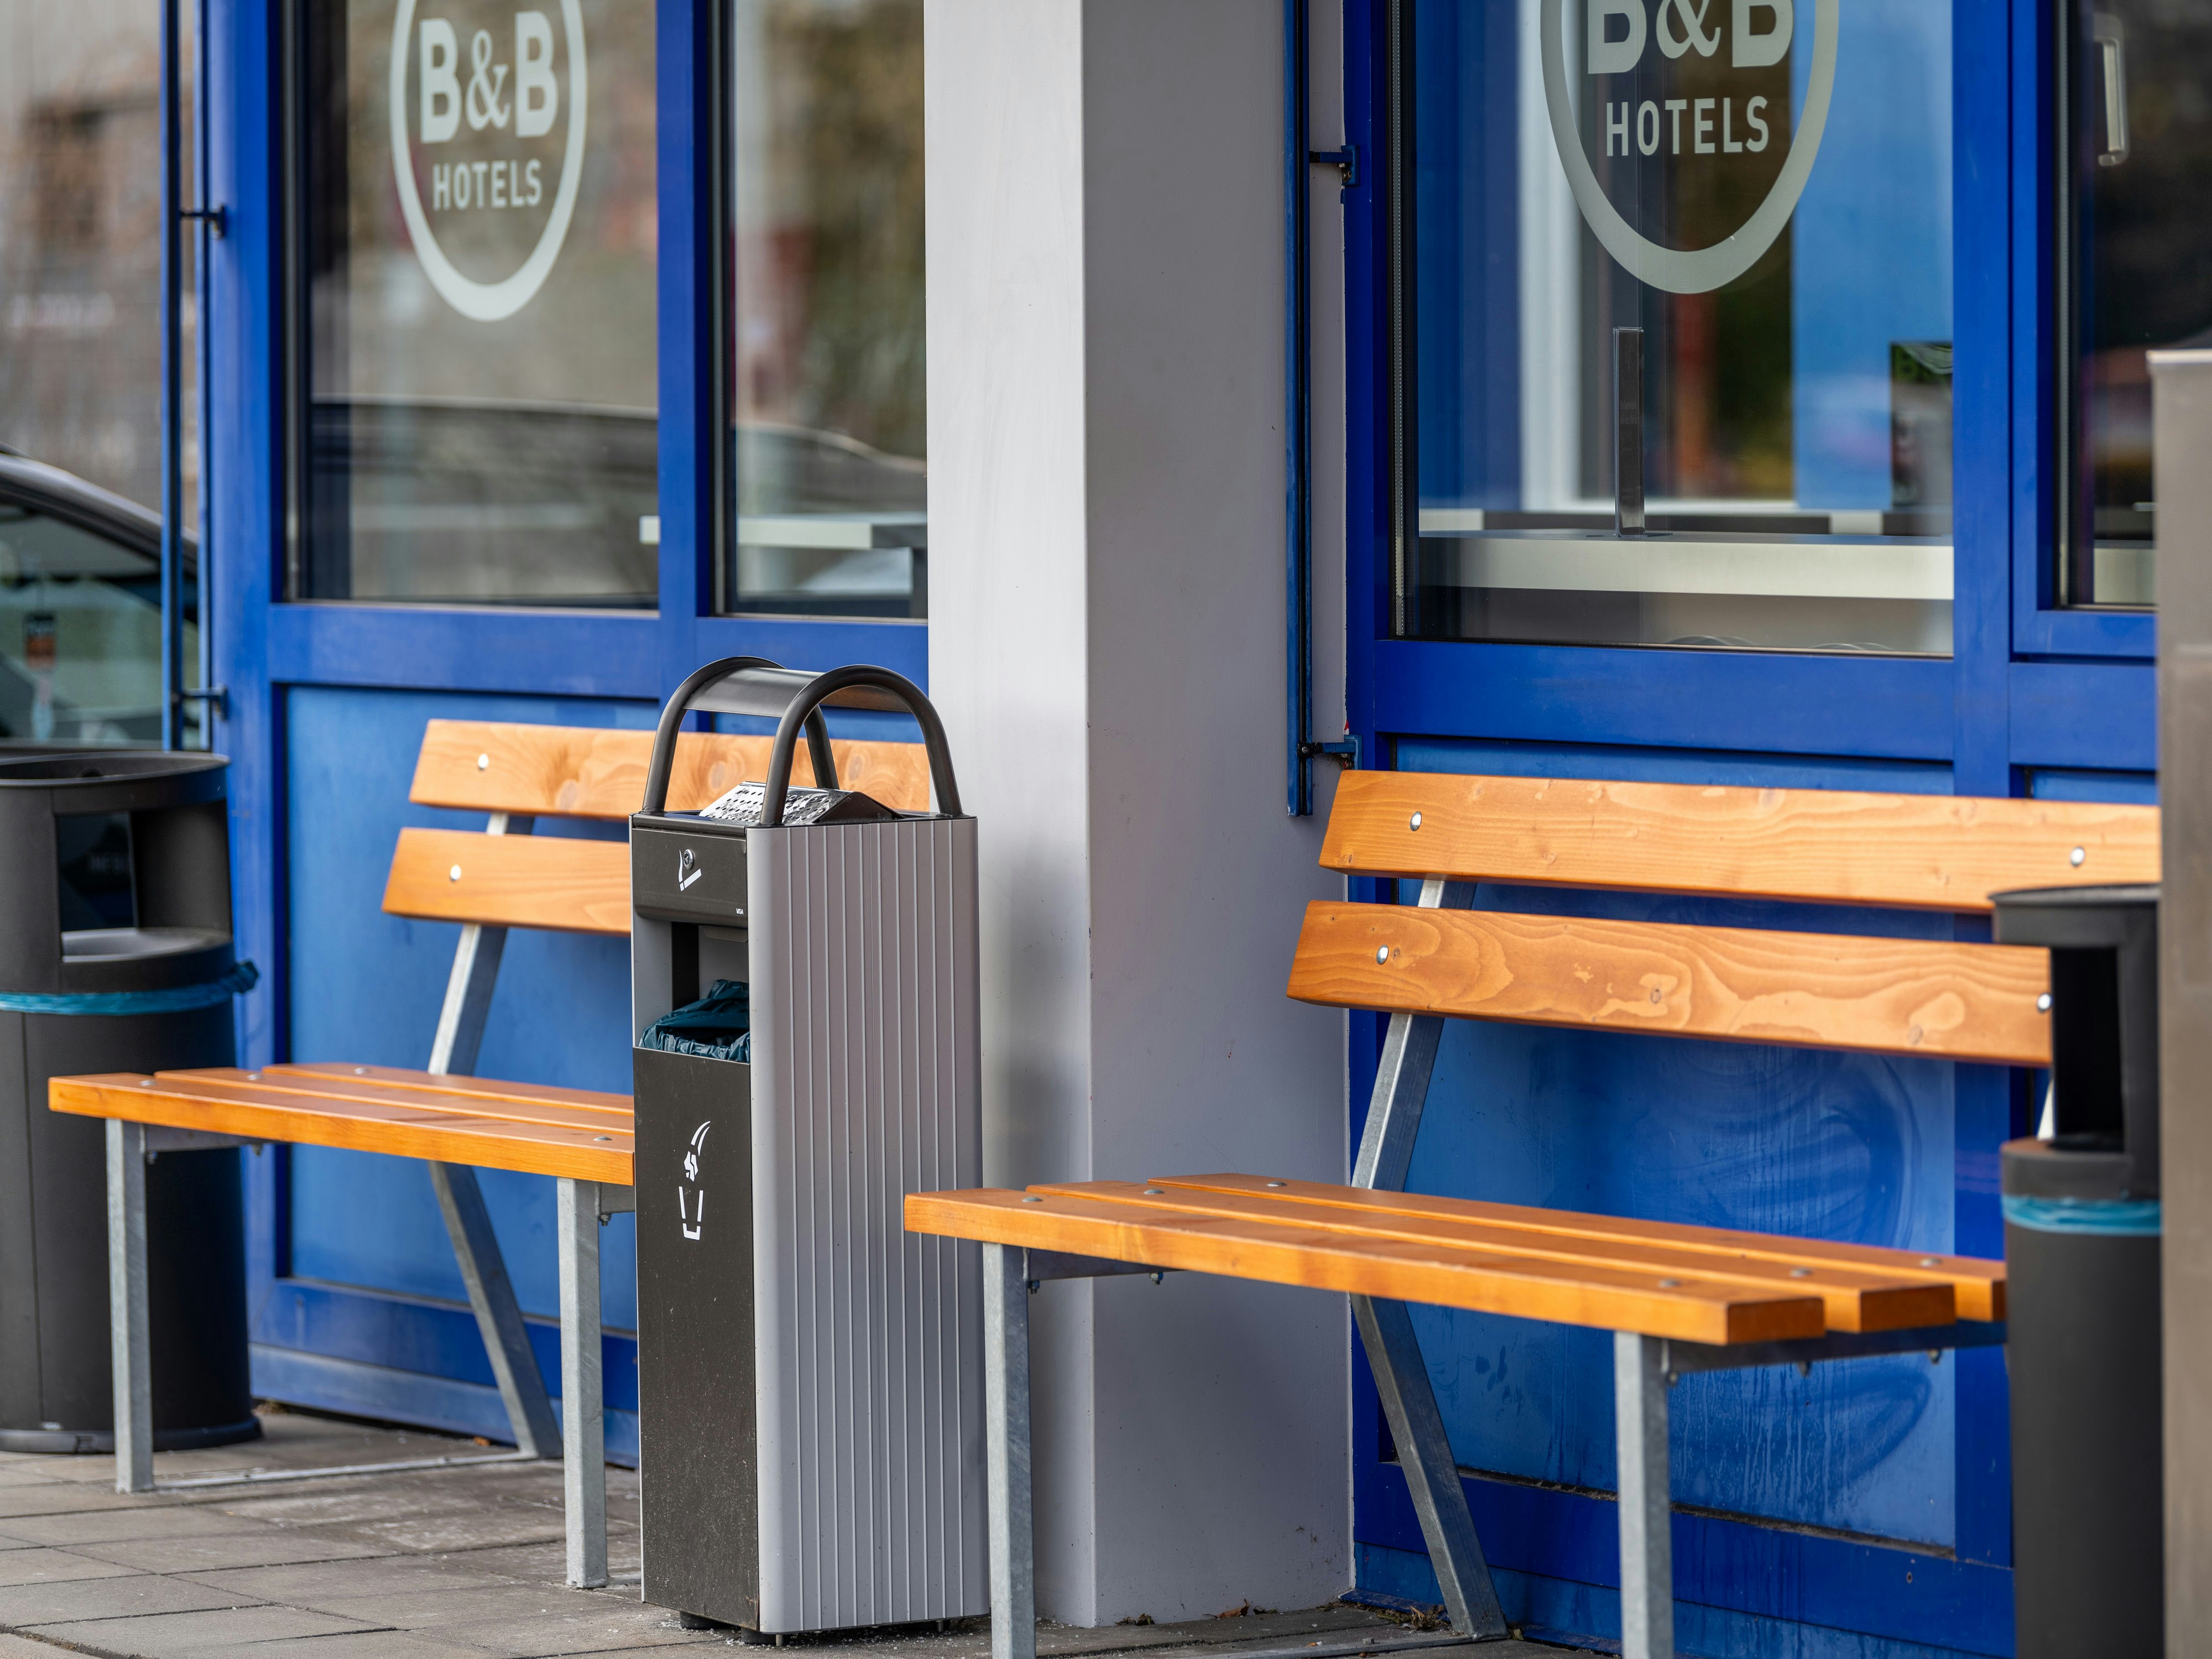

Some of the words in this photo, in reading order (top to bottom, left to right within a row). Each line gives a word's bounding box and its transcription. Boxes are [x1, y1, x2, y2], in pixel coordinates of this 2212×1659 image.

[420, 11, 559, 143] B&B
[1606, 95, 1769, 156] HOTELS
[432, 158, 542, 211] HOTELS
